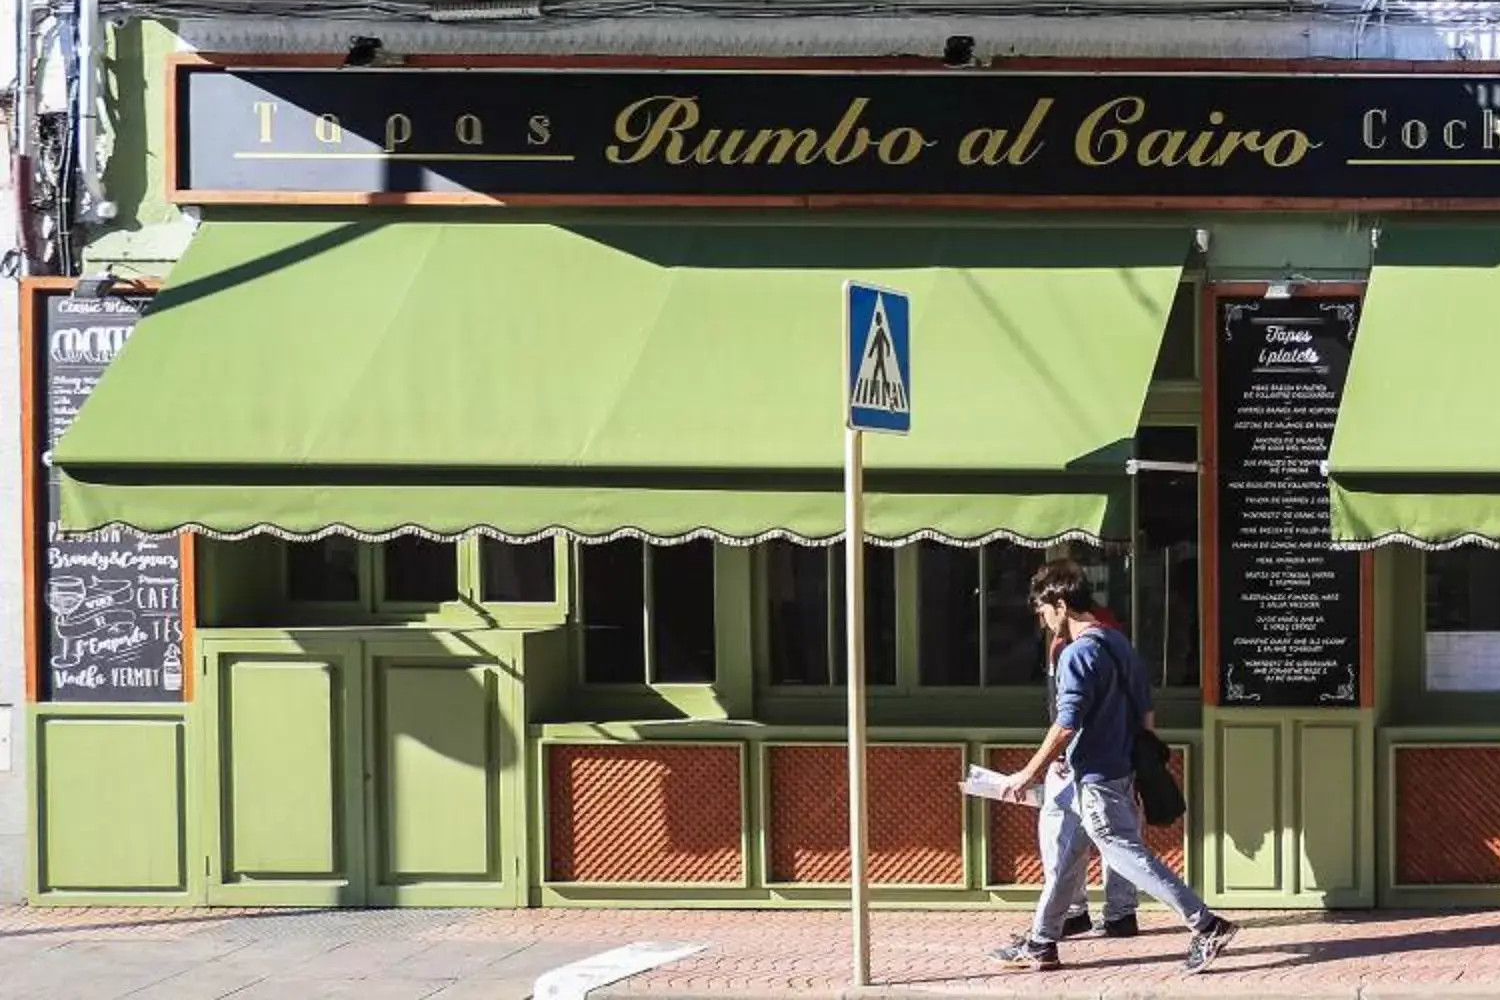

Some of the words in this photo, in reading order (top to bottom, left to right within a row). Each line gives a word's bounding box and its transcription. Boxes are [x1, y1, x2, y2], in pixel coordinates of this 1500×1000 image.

[253, 101, 551, 151] Tapas
[605, 94, 937, 166] Rumbo
[955, 97, 1055, 167] al
[1074, 96, 1323, 168] Cairo
